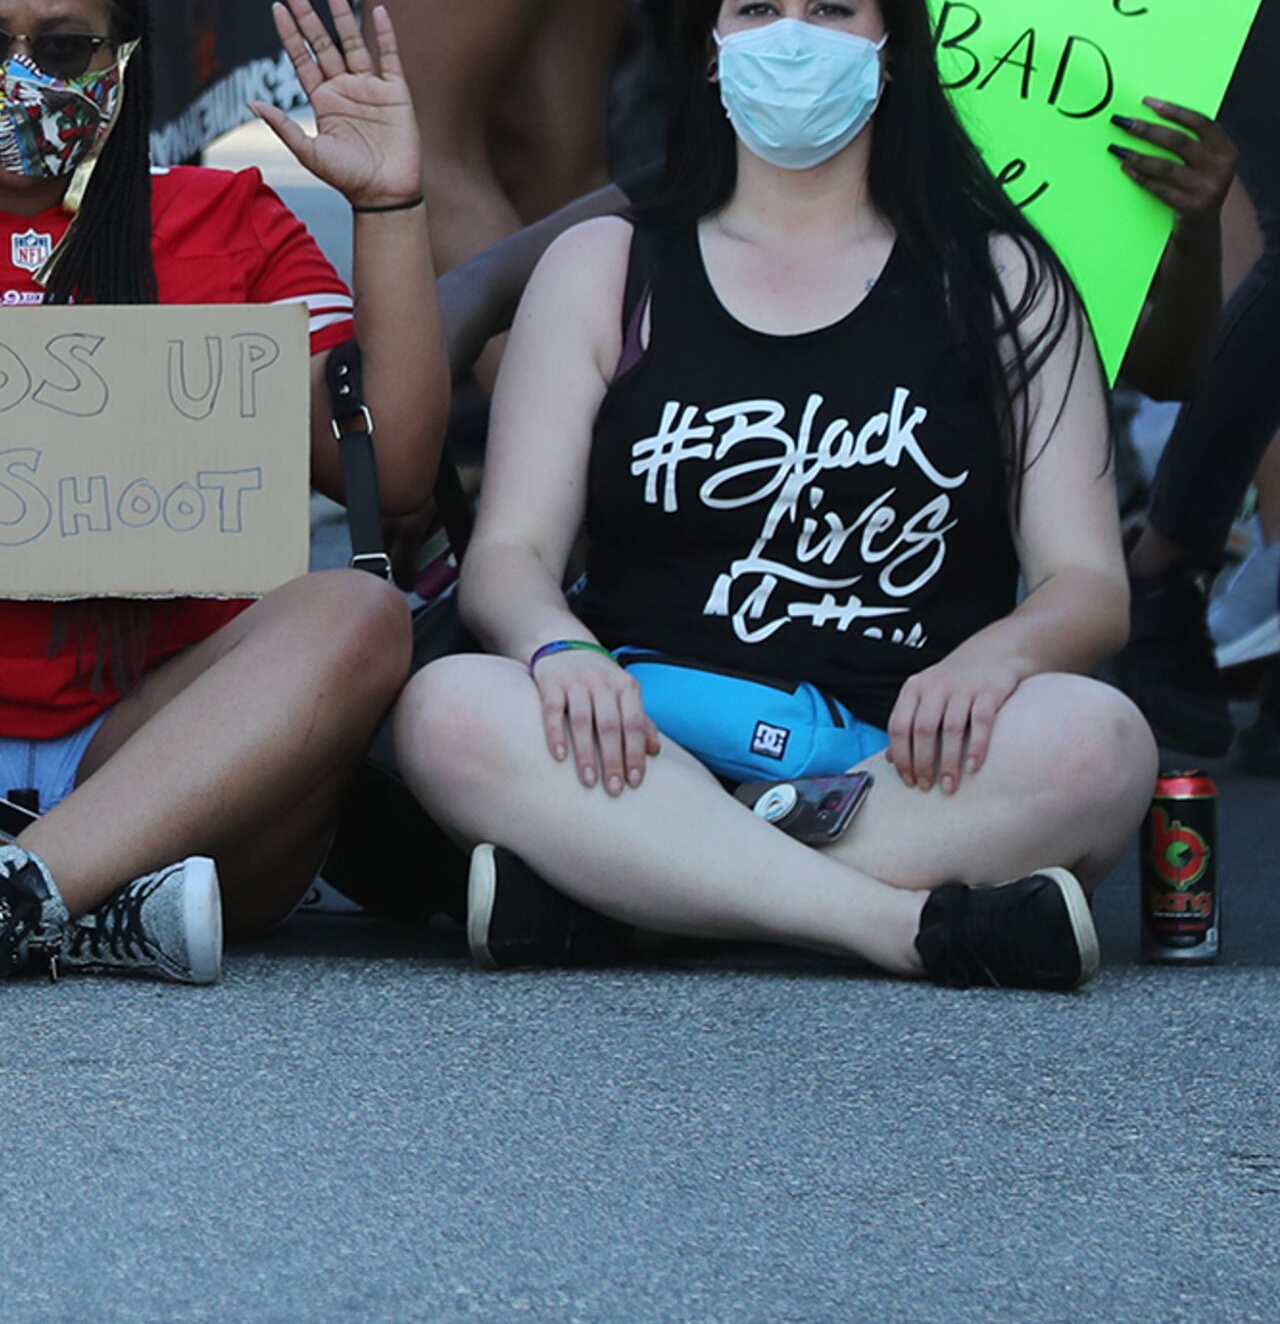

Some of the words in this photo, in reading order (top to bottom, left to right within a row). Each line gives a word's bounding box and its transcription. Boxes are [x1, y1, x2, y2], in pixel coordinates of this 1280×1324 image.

[934, 1, 1114, 119] BAD
[167, 332, 280, 420] UP
[631, 386, 968, 512] #Black
[731, 473, 959, 597] Lives
